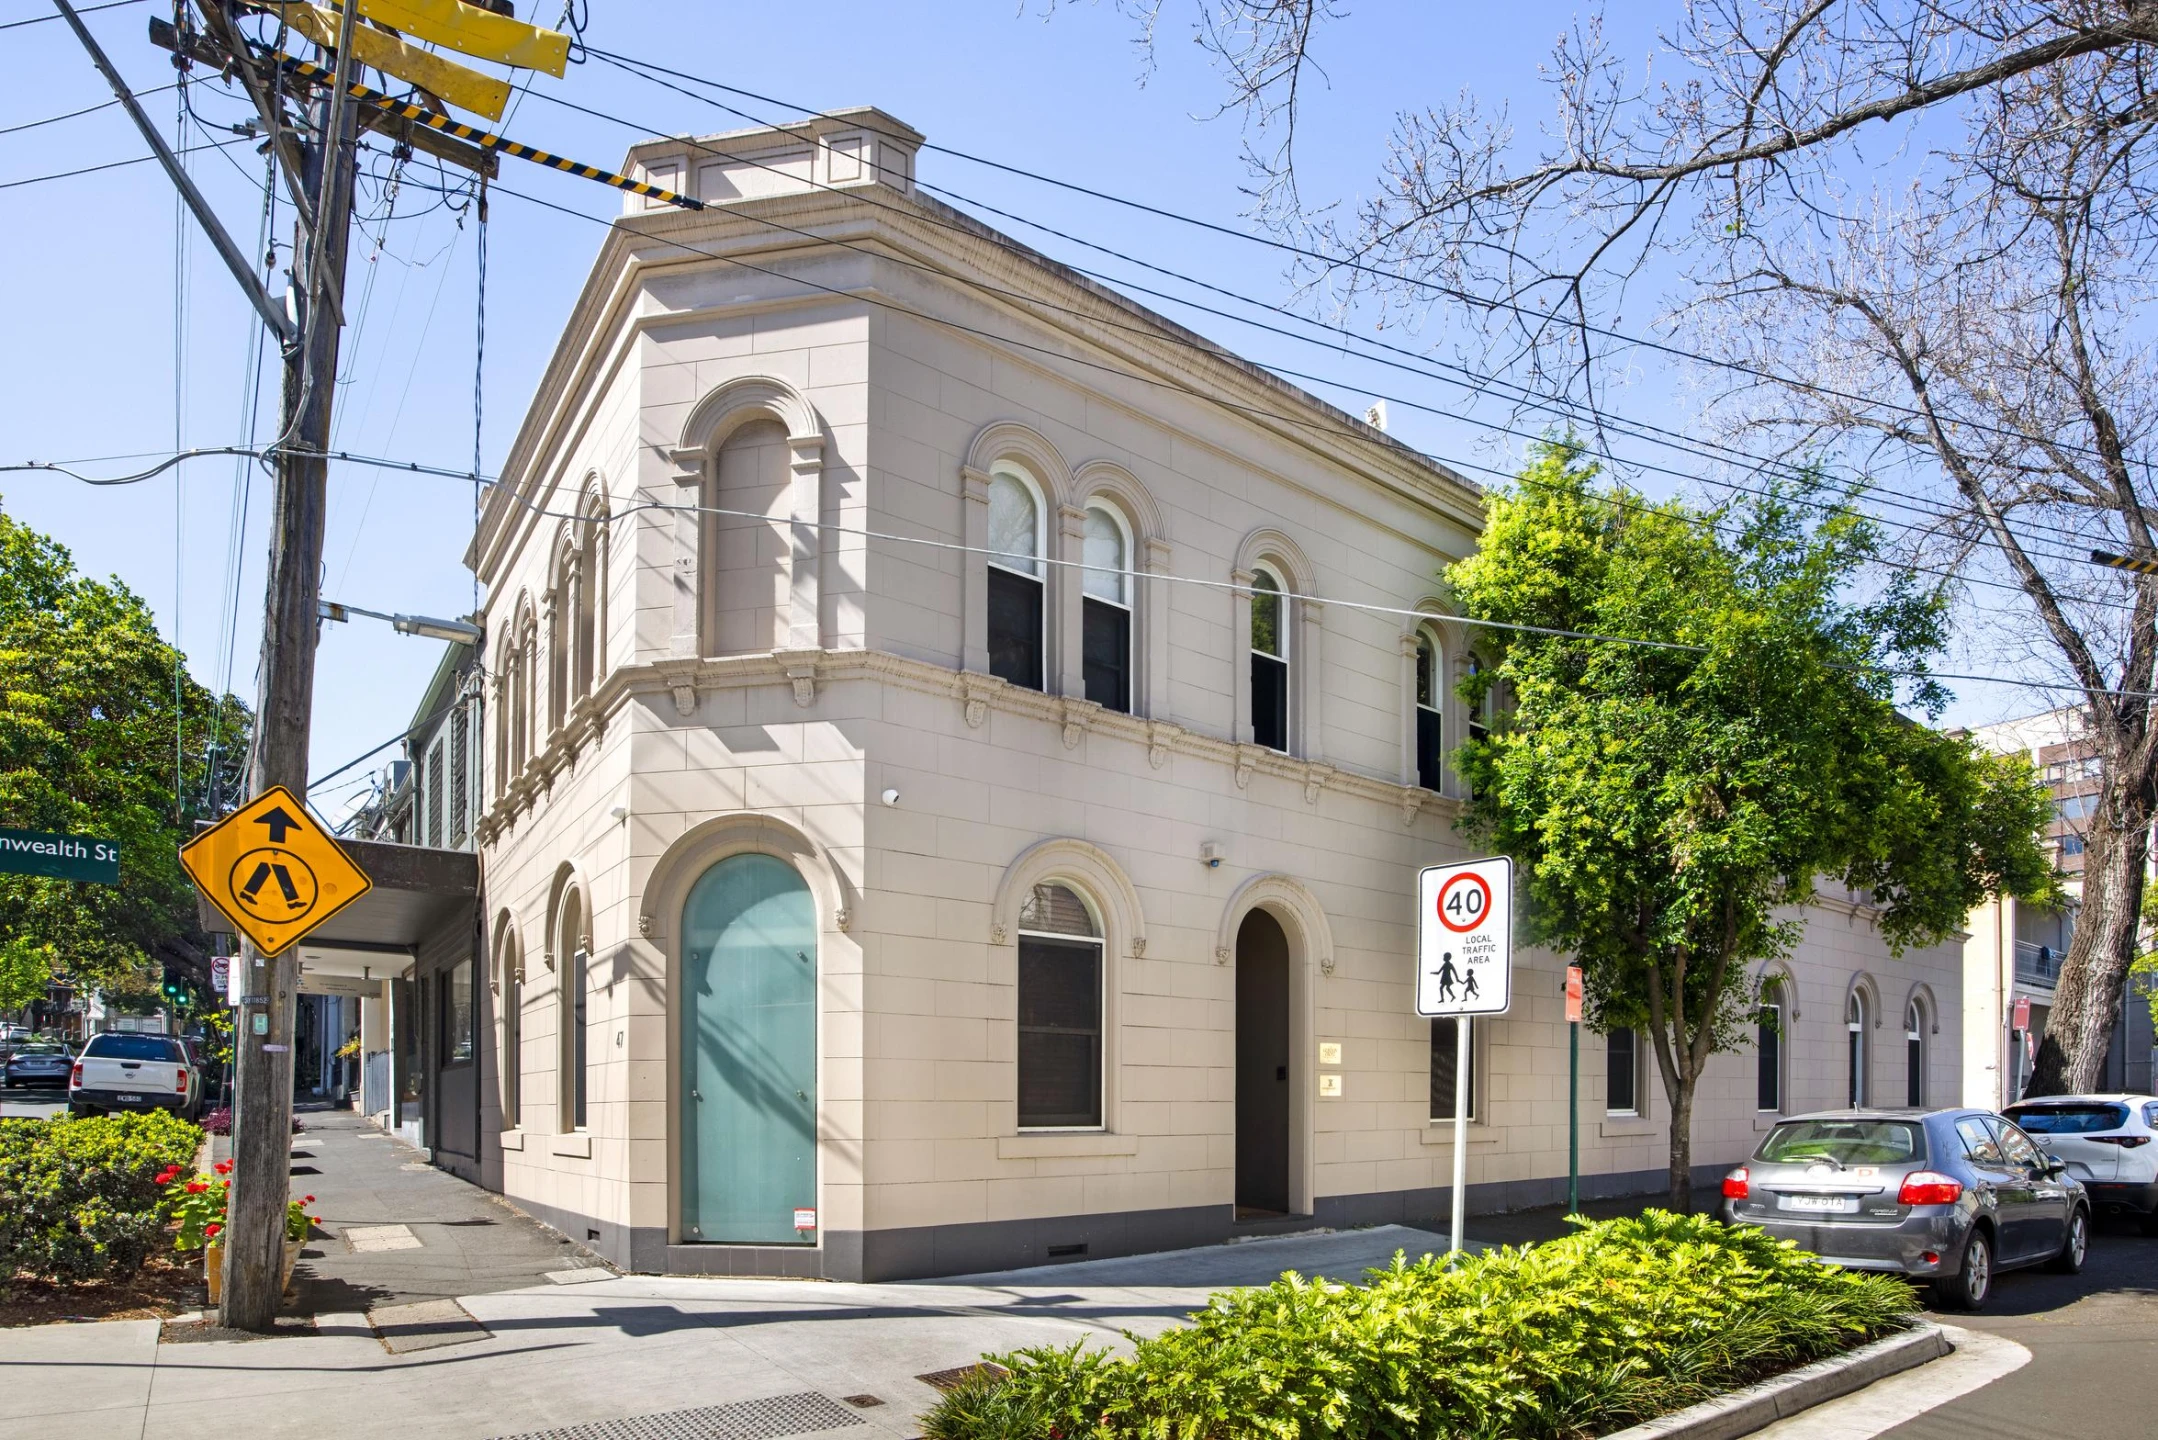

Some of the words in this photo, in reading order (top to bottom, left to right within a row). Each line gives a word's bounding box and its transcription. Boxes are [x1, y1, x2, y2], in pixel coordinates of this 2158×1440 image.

[94, 844, 117, 862] St
[1446, 889, 1482, 915] 40
[1465, 935, 1492, 944] LOCAL
[1462, 944, 1496, 954] TRAFFIC
[1467, 956, 1490, 964] AREA
